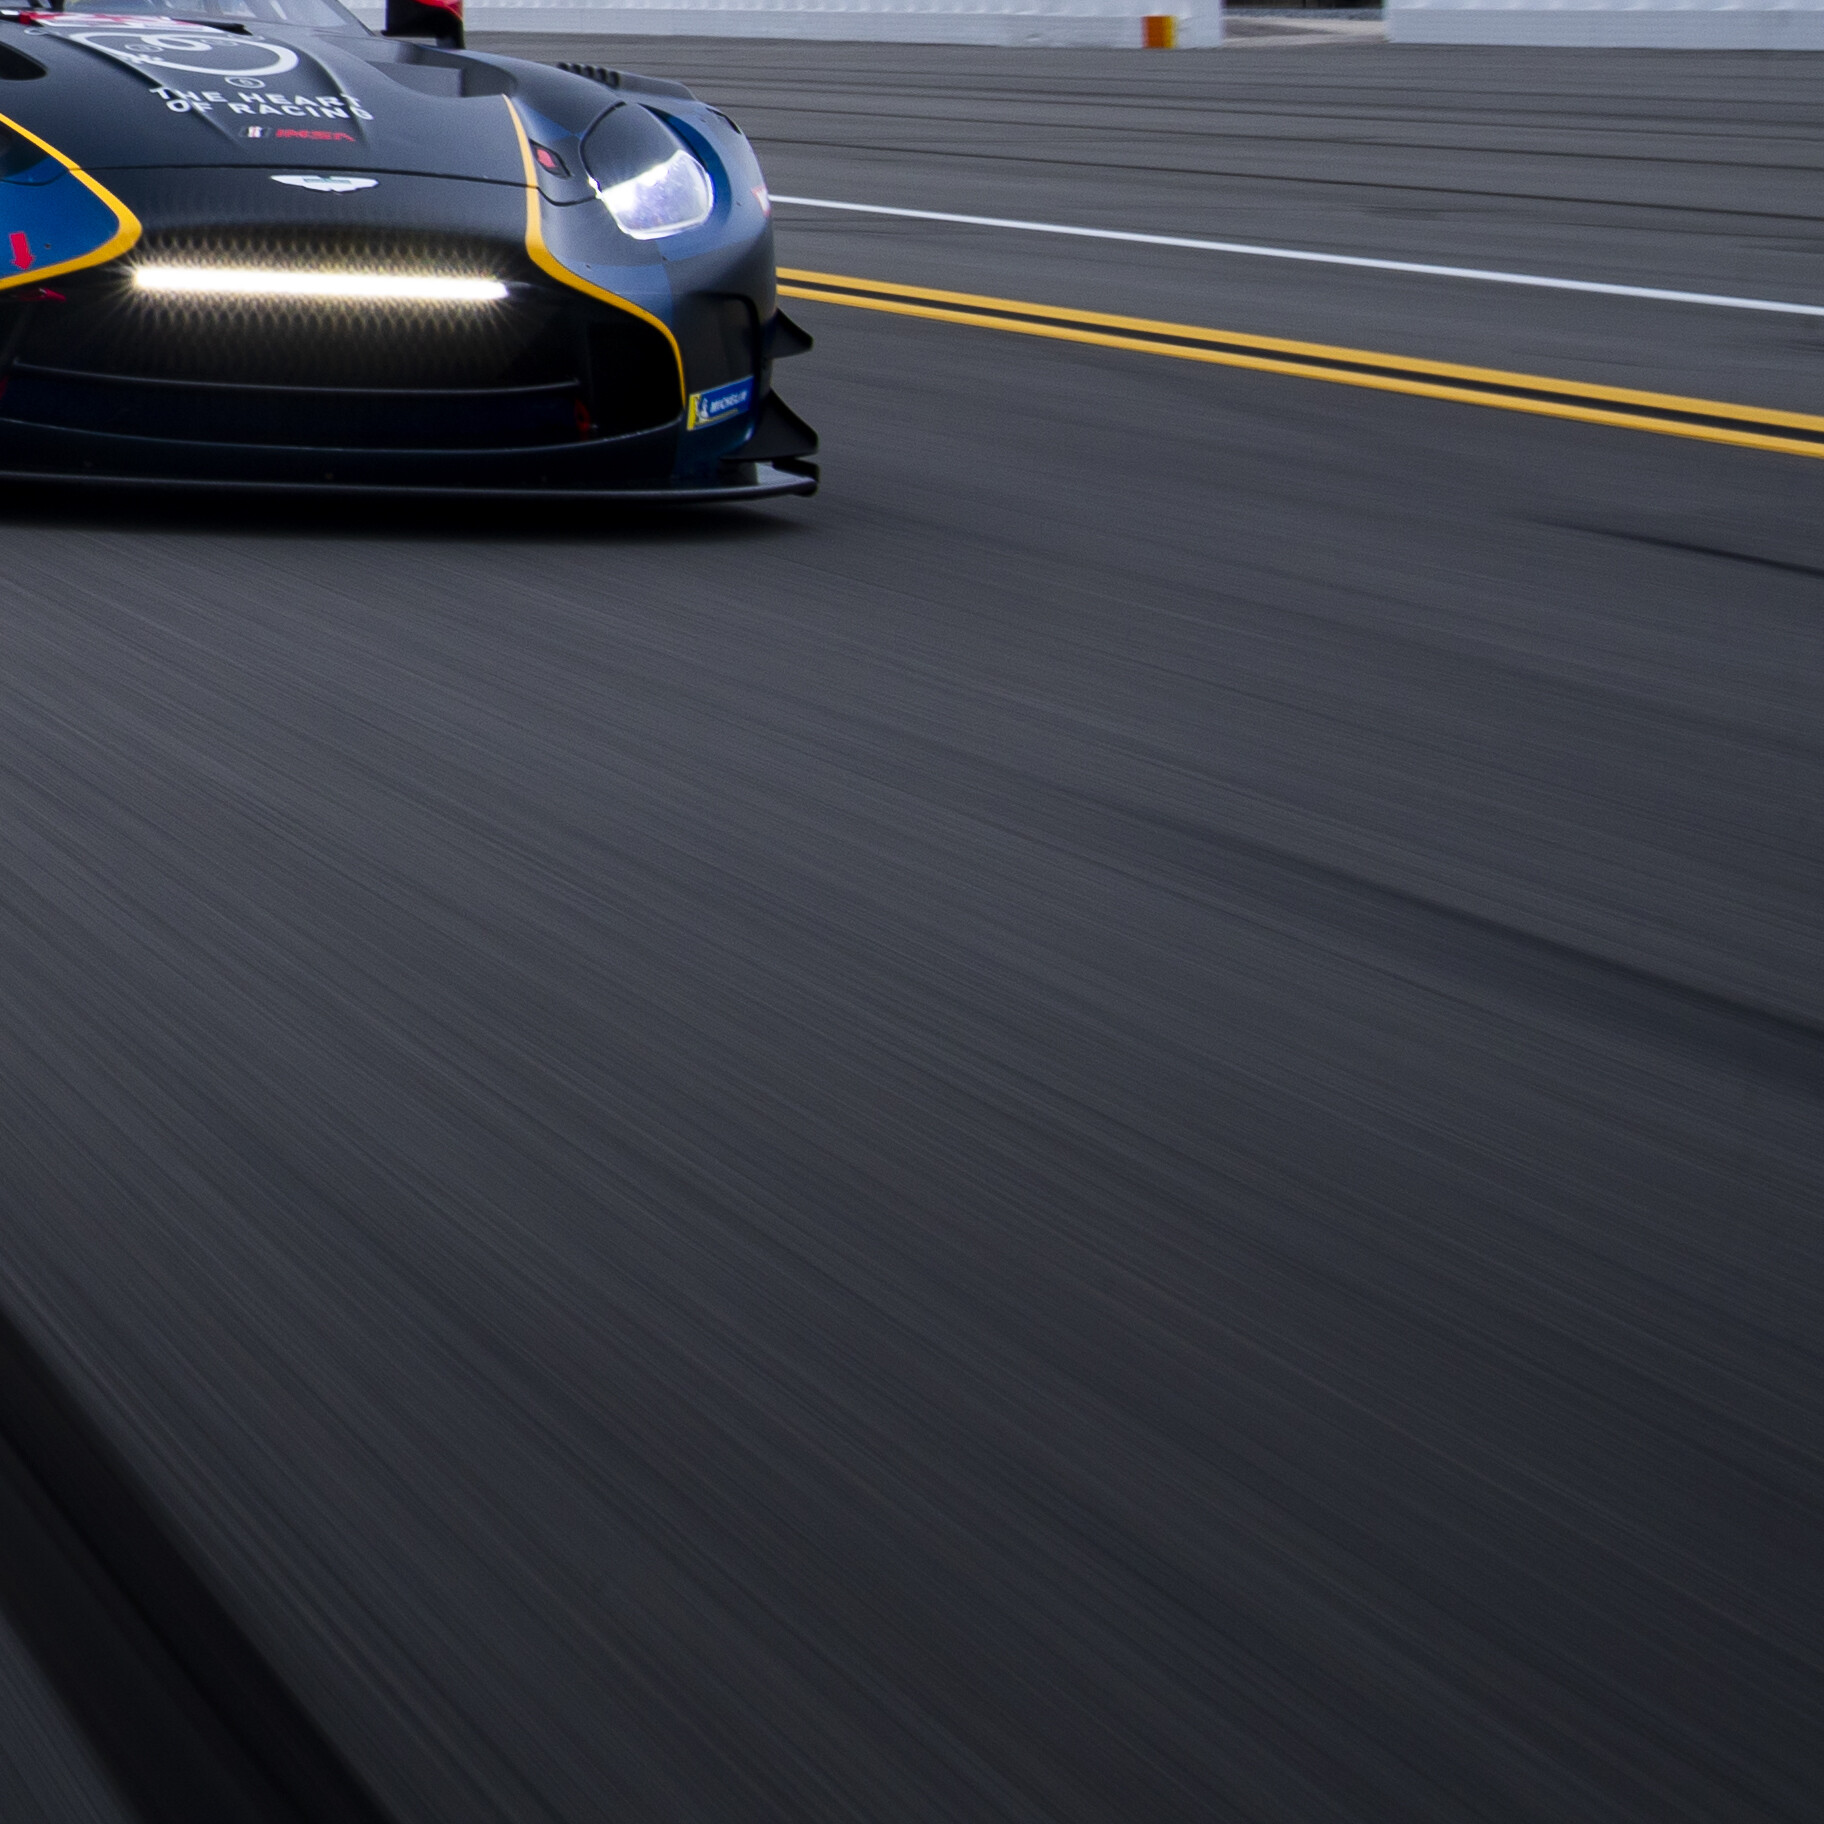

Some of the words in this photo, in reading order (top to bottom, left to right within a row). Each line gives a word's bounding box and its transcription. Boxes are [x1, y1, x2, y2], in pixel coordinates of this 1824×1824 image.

[149, 87, 229, 103] THE
[237, 92, 362, 108] HEART
[166, 99, 214, 113] OF
[228, 102, 374, 120] RACING
